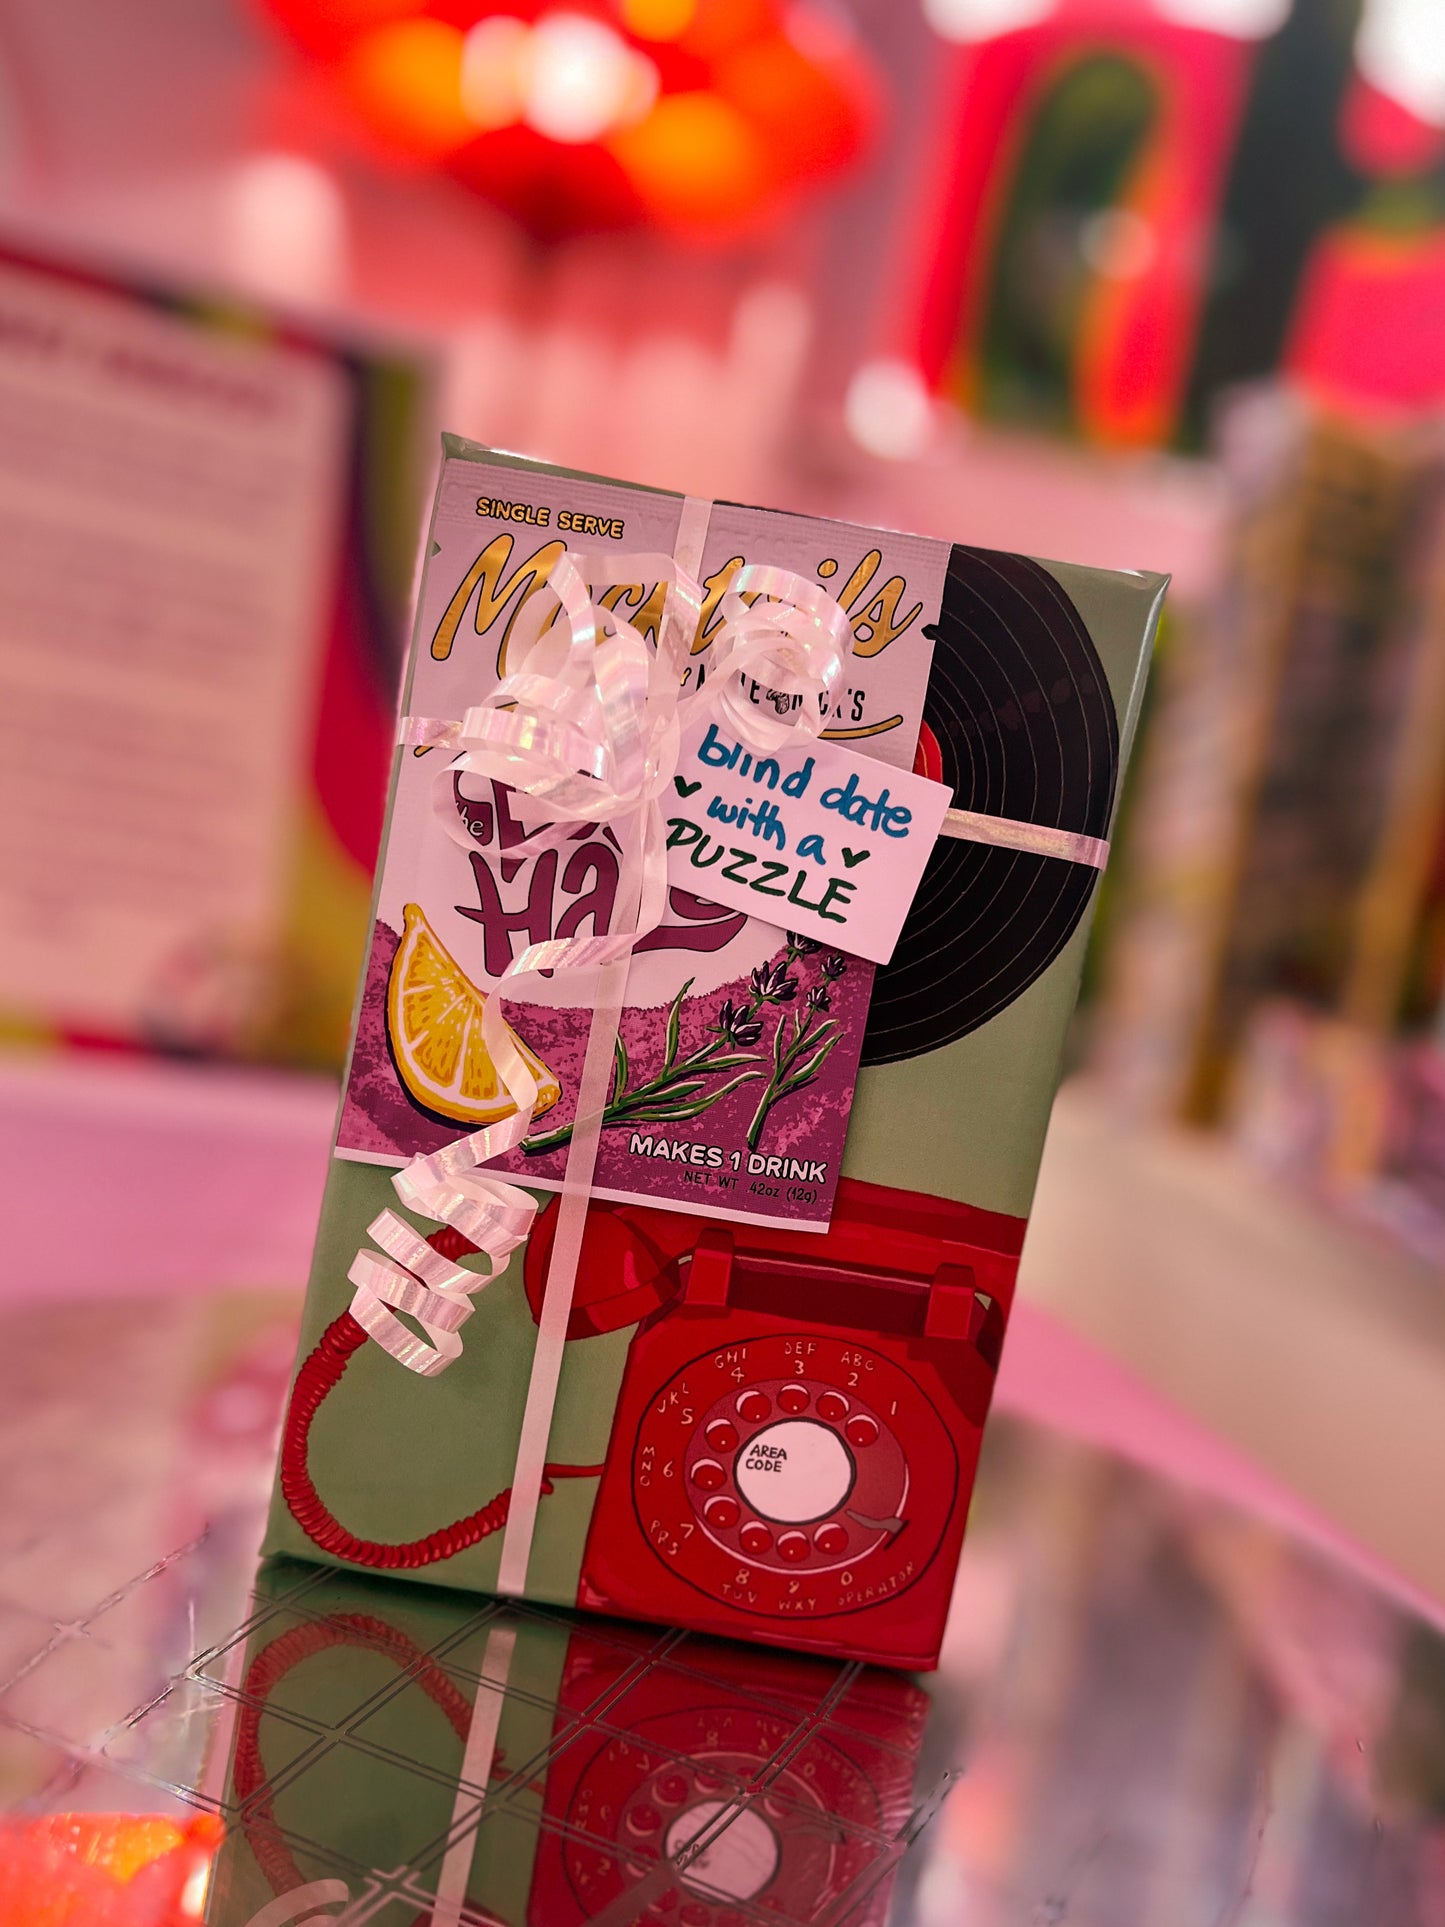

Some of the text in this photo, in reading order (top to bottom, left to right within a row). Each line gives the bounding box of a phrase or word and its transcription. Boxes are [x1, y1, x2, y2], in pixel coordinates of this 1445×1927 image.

[476, 497, 625, 539] SINGLE SERVE
[697, 723, 913, 838] blind date
[455, 801, 485, 837] he
[706, 795, 827, 867] with a
[666, 817, 858, 924] PUZZLE
[629, 1132, 828, 1184] MAKES 1 DRINK
[684, 1170, 818, 1205] NET WT .42oz (12g)
[784, 1341, 816, 1356] DEF
[794, 1359, 805, 1375] 3
[840, 1351, 875, 1371] ABC
[730, 1366, 745, 1384] 4
[847, 1372, 859, 1387] 2
[680, 1407, 694, 1426] 5
[889, 1400, 898, 1416] 1
[749, 1443, 788, 1461] AREA
[662, 1460, 674, 1478] 6
[745, 1458, 783, 1473] CODE
[680, 1523, 695, 1540] 7
[735, 1568, 751, 1585] 8
[840, 1571, 853, 1586] 0
[721, 1583, 758, 1604] TUV
[788, 1579, 801, 1594] 9
[778, 1597, 817, 1612] WXY
